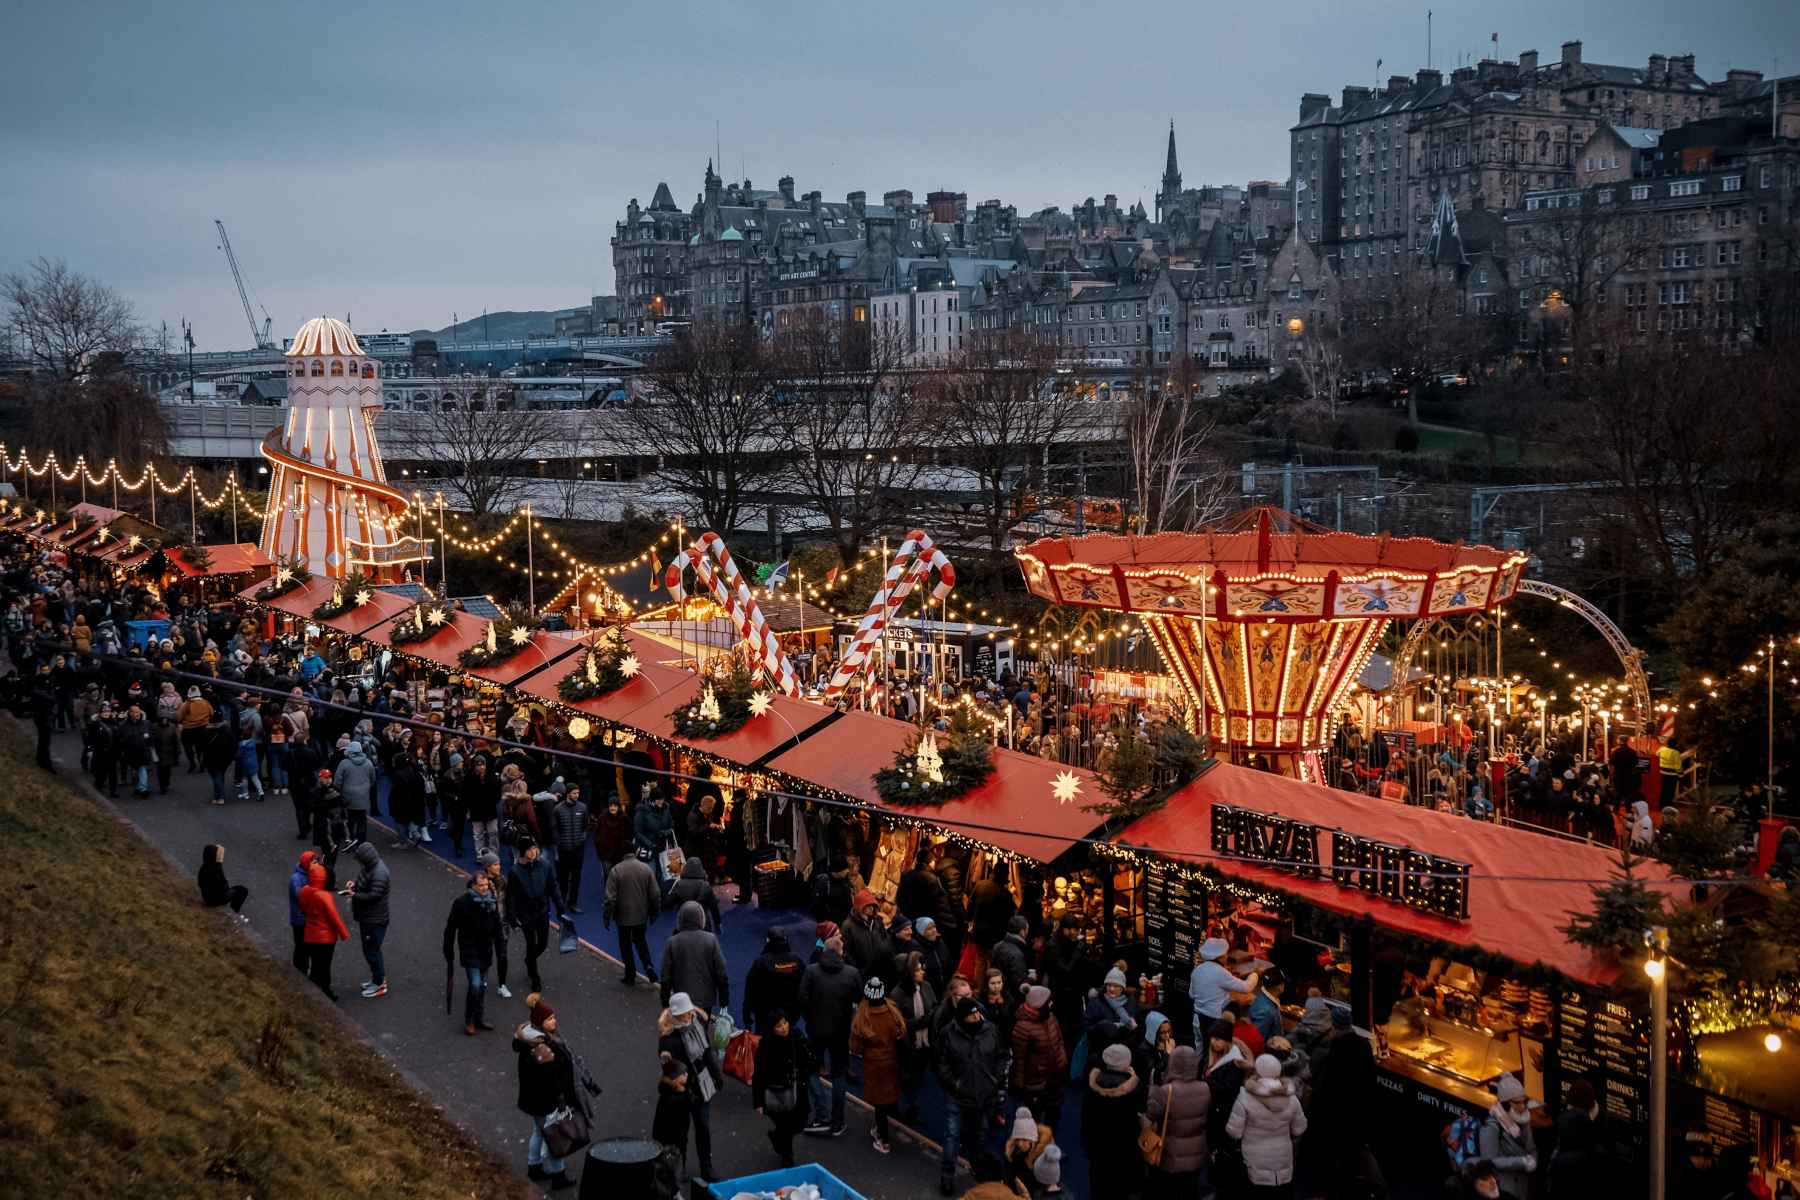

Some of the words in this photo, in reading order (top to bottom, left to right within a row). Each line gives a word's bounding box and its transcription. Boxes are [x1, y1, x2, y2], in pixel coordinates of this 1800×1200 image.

[800, 270, 817, 278] CENTRE
[1211, 803, 1320, 879] PIZZA
[1377, 1075, 1404, 1093] PIZZAS
[1417, 1091, 1440, 1107] DIRTY
[1444, 1101, 1468, 1117] FRIES
